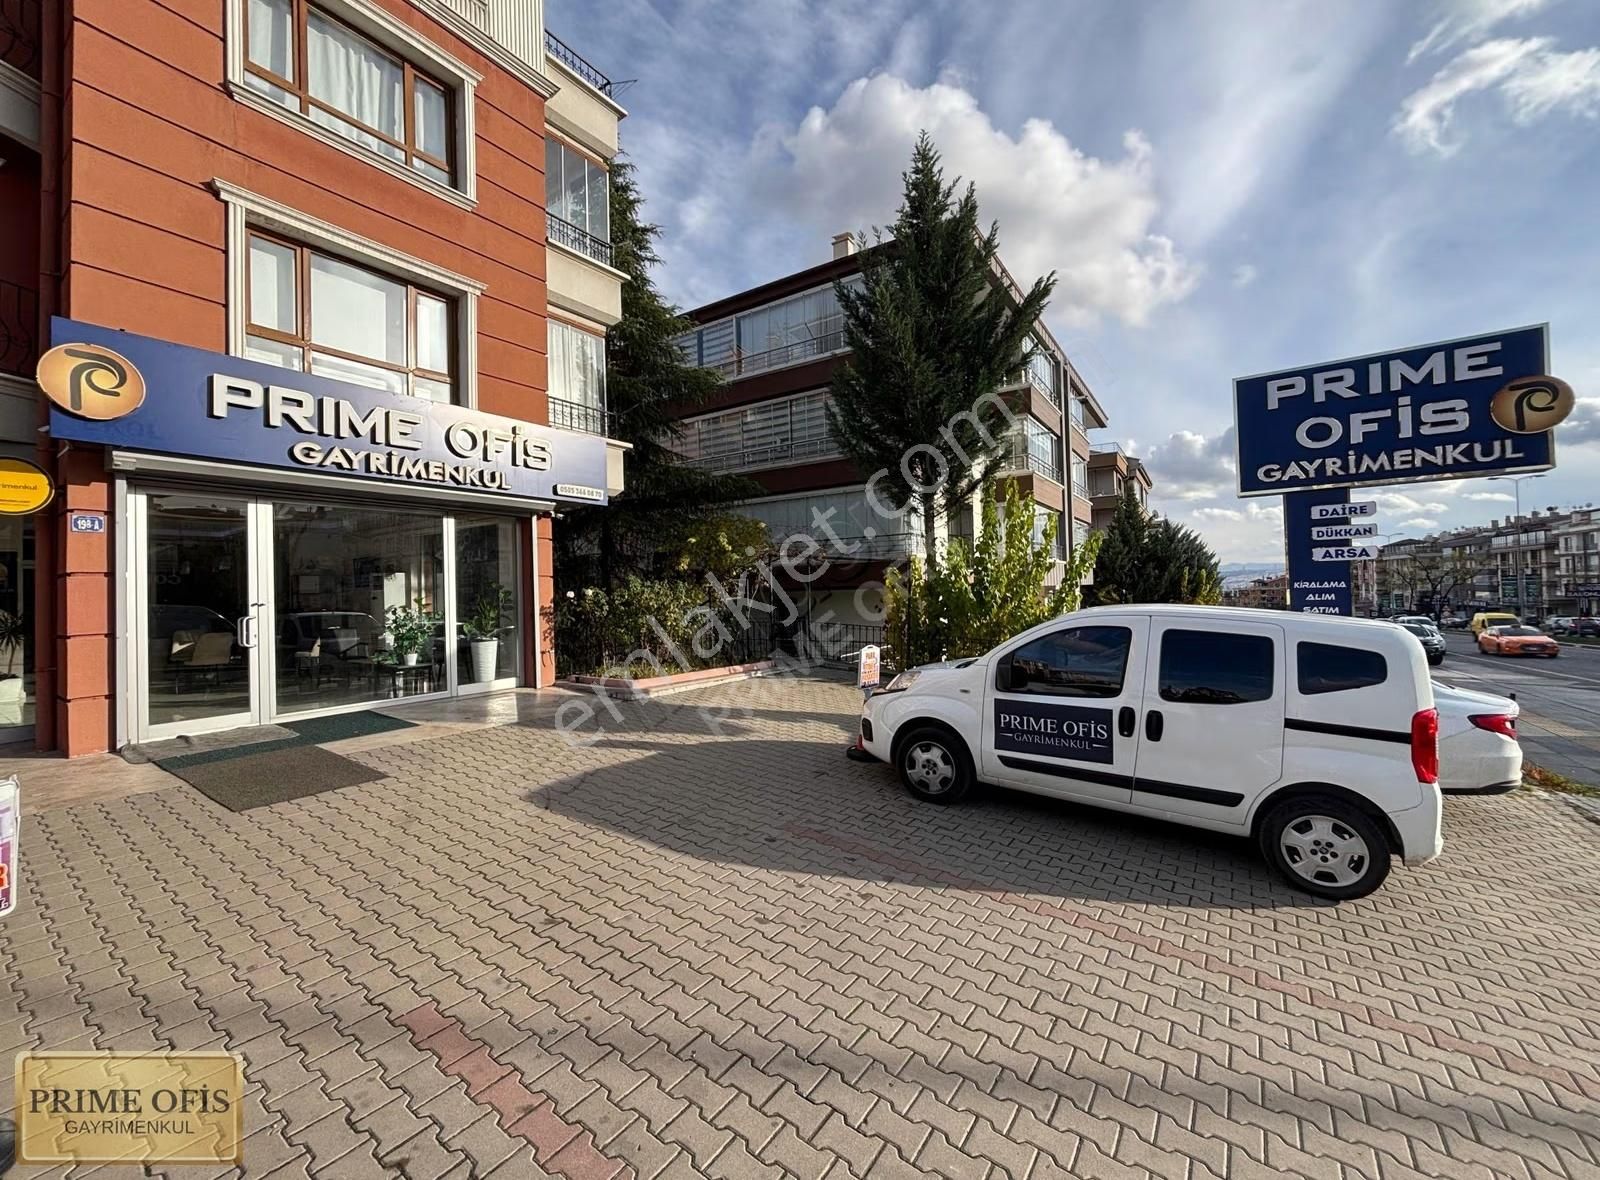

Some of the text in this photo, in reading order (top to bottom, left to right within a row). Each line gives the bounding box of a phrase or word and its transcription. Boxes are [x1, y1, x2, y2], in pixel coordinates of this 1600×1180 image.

[1266, 342, 1502, 410] PRIME
[208, 373, 553, 471] PRIME OFİS
[1296, 396, 1469, 449] OFİS
[290, 440, 511, 490] GAYRİMENKUL
[1256, 438, 1524, 483] GAYRİMENKUL
[1319, 504, 1368, 517] DAİRE
[1316, 526, 1372, 539] DÜKKAN
[1321, 547, 1371, 560] ARSA
[1293, 579, 1347, 589] KİRALAMA
[1305, 592, 1336, 601] ALIM
[1302, 606, 1340, 614] SATIM
[999, 713, 1108, 740] PRIME OFİS
[1013, 732, 1092, 750] GAYRİMENKUL
